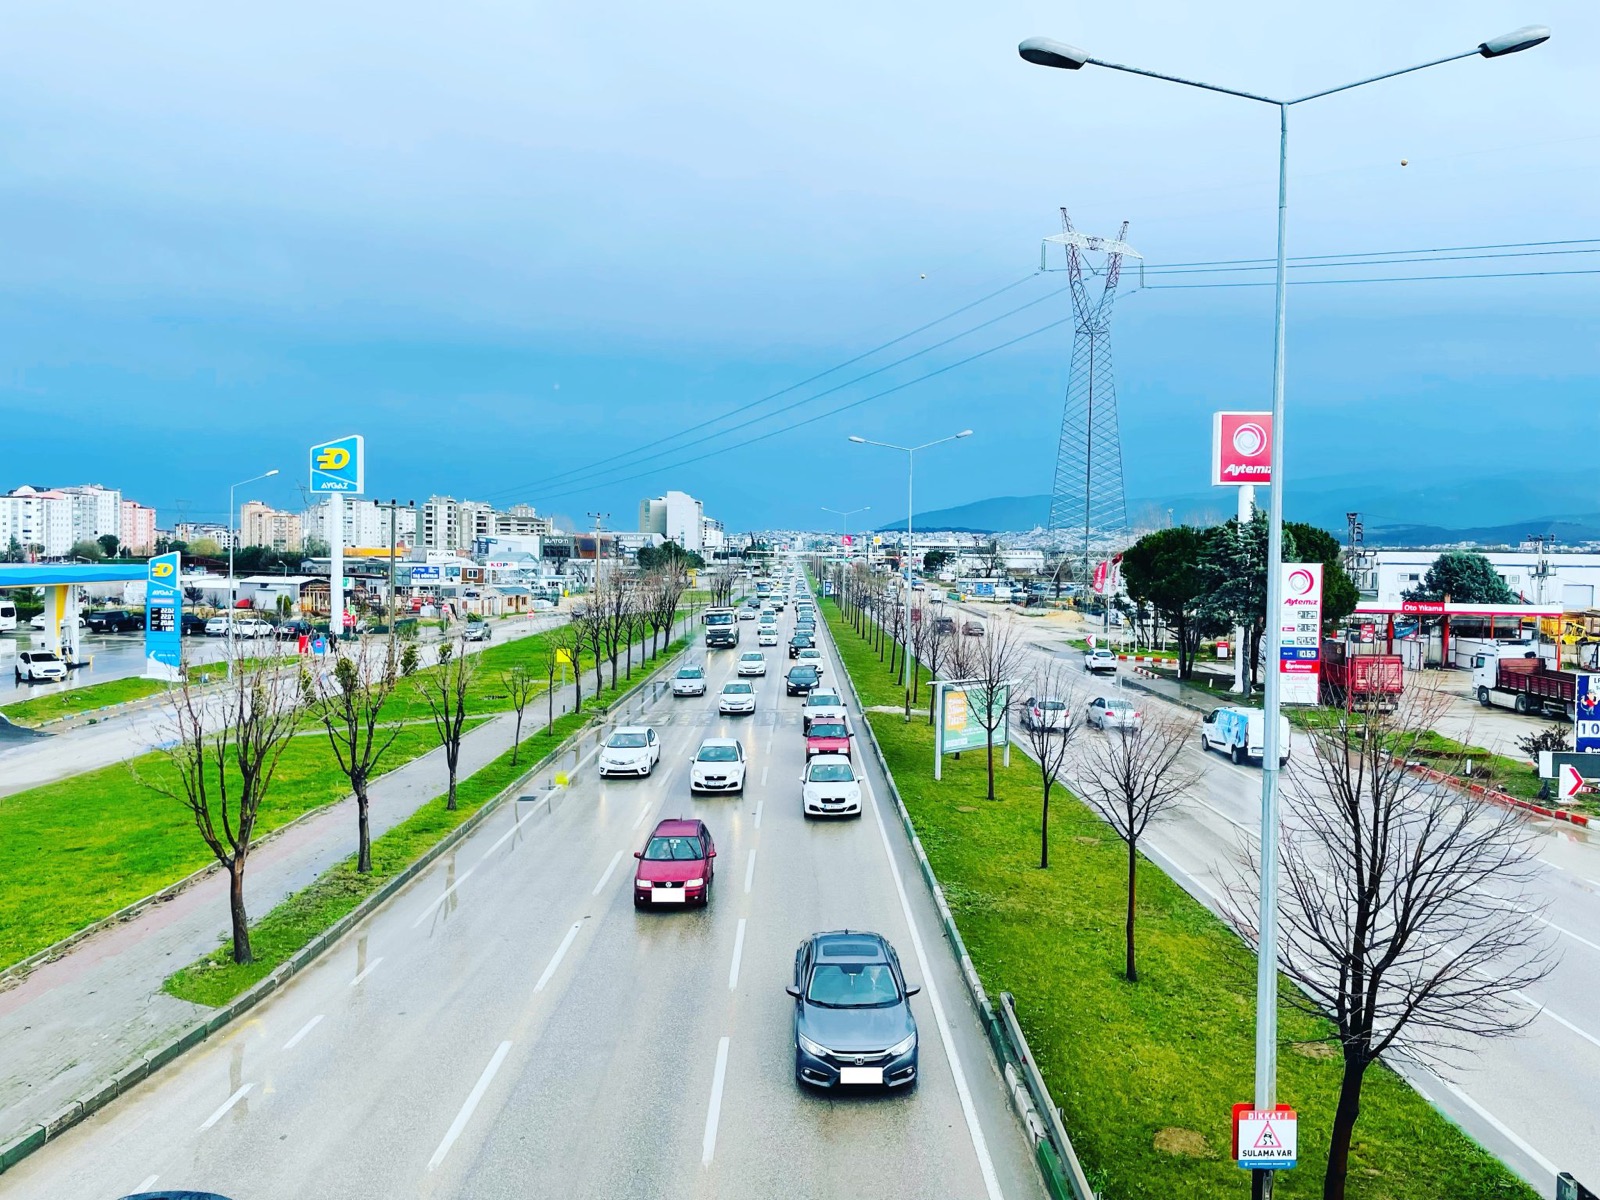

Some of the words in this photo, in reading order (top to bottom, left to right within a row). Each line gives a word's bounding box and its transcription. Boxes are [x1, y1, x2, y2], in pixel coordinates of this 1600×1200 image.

[1284, 598, 1318, 606] Aytemiz
[1242, 1149, 1275, 1157] SULAMA
[1276, 1149, 1292, 1157] VAR
